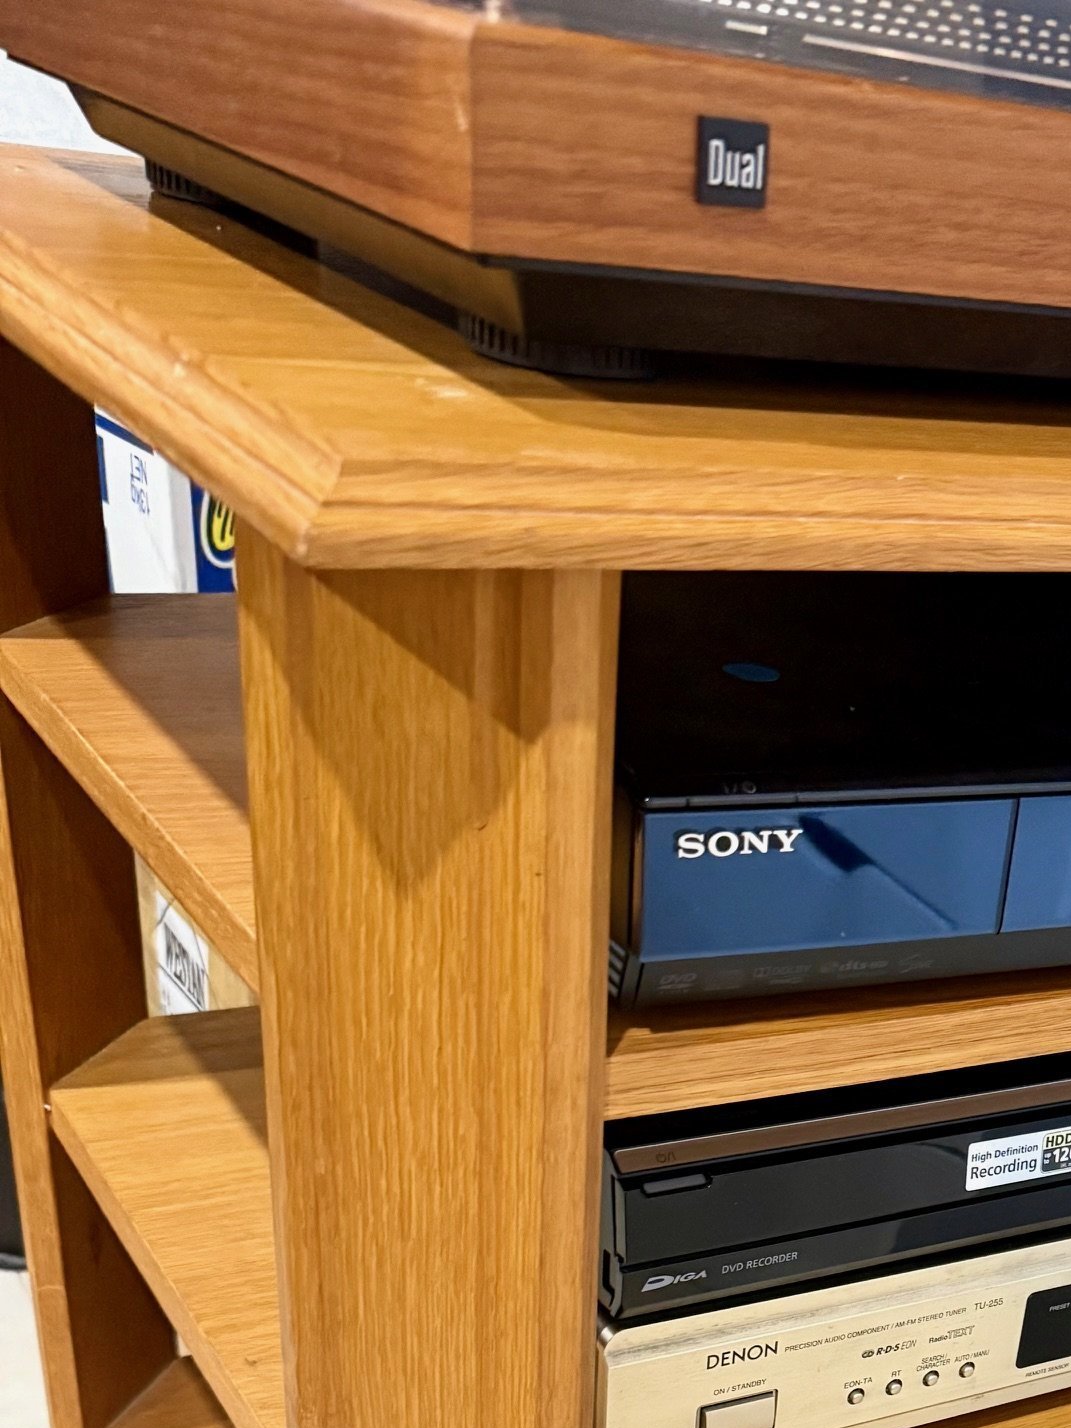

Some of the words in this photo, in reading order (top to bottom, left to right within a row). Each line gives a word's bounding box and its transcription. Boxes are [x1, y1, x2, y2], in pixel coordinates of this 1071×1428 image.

[707, 138, 765, 190] Dual
[677, 829, 803, 859] SONY
[971, 1150, 992, 1163] High
[994, 1143, 1039, 1159] Definition
[970, 1158, 1038, 1180] Recording
[641, 1270, 708, 1293] DIGA
[721, 1262, 744, 1275] DVD
[745, 1251, 798, 1270] RECORDER
[706, 1340, 779, 1370] DENON
[784, 1339, 823, 1353] PRECISION
[824, 1333, 846, 1344] AUDIO
[846, 1324, 890, 1339] COMPONENT
[895, 1318, 917, 1328] AM-FM
[917, 1312, 944, 1324] STEREO
[945, 1307, 967, 1318] TUNER
[974, 1297, 1004, 1312] TU-255
[900, 1339, 918, 1351] EON
[916, 1359, 951, 1372] CHARACTER
[921, 1354, 944, 1364] SEARCH
[954, 1353, 970, 1363] AUTO
[713, 1387, 726, 1397] ON
[731, 1378, 767, 1393] STANDBY
[843, 1376, 873, 1390] EON-TA
